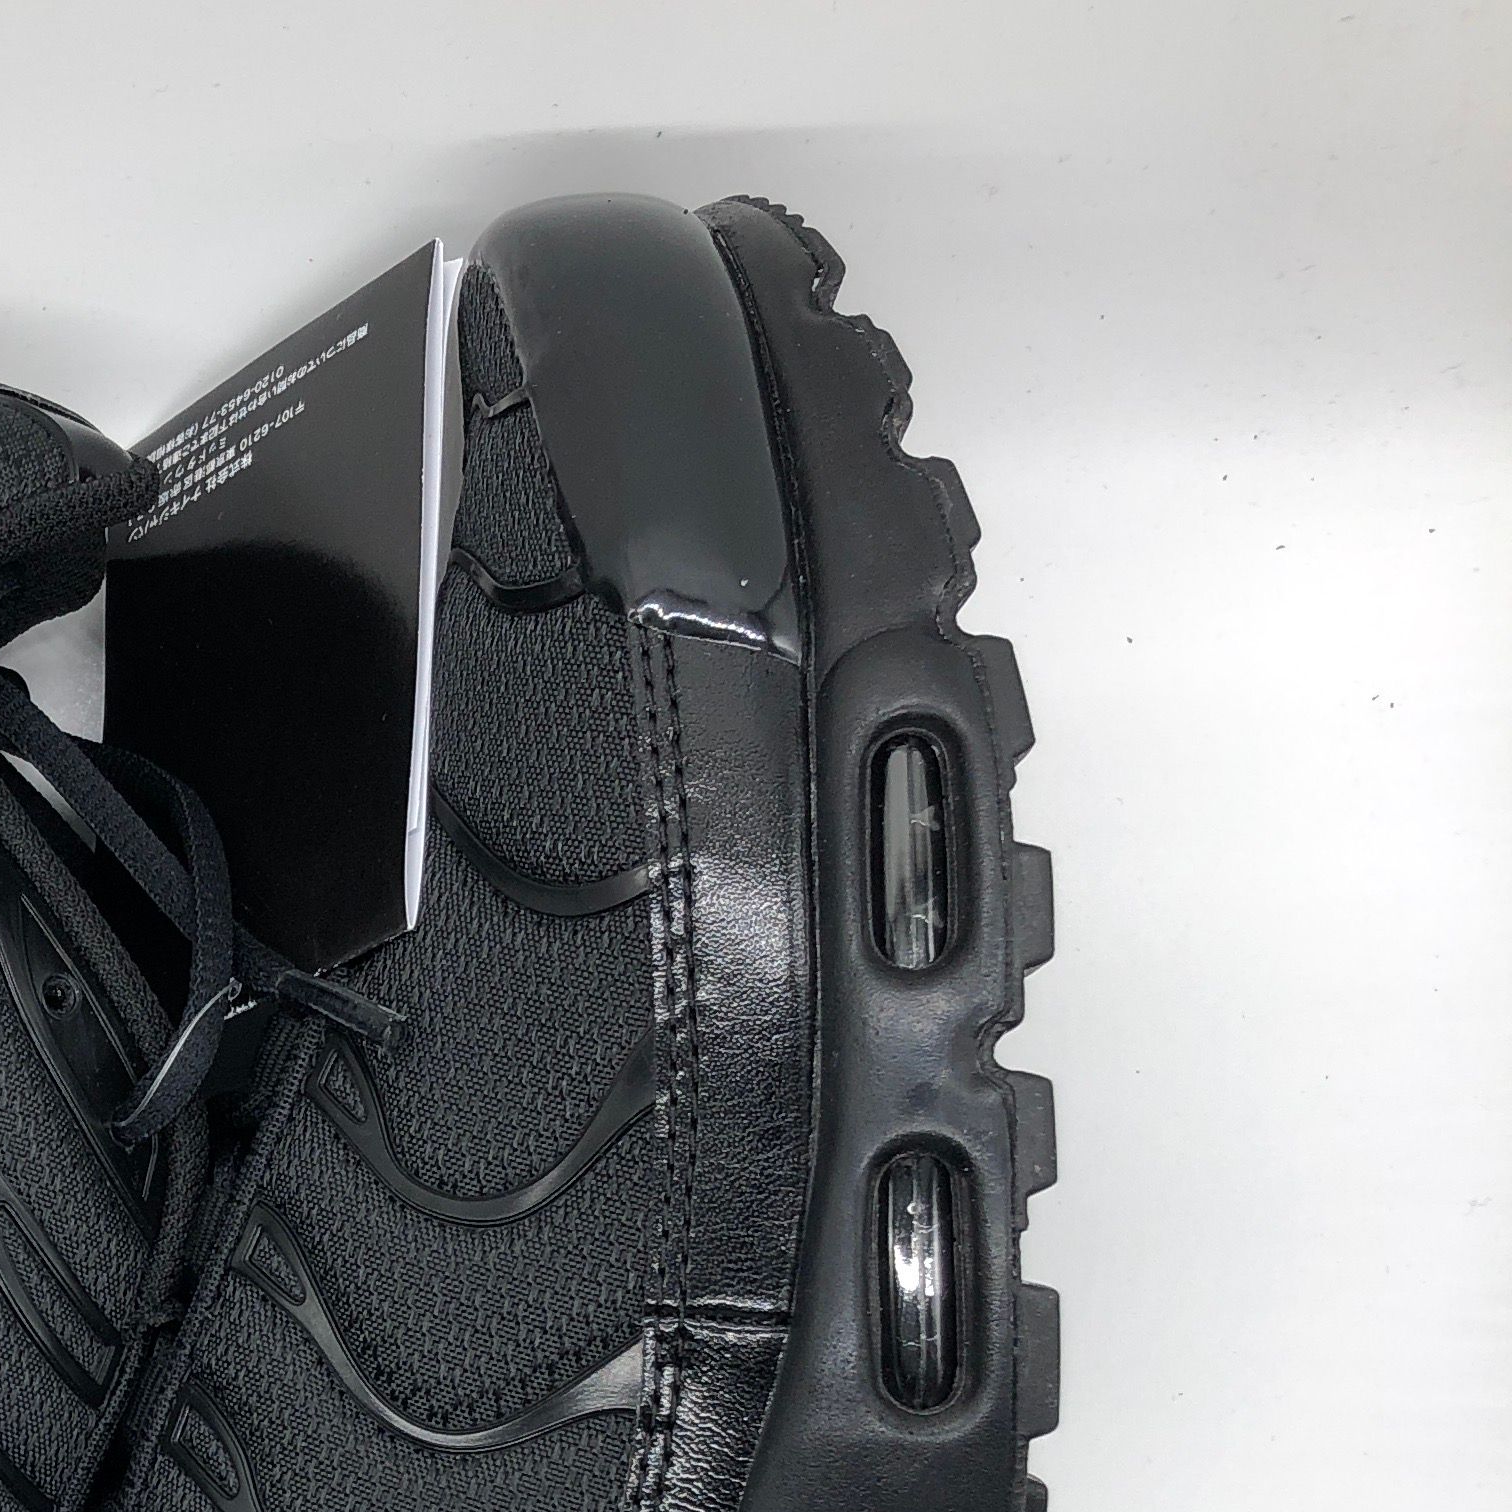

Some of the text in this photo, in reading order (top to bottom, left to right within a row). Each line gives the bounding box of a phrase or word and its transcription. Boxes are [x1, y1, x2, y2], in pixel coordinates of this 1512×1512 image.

[205, 449, 253, 493] 株式会社
[128, 484, 202, 542] ナイキジャパン
